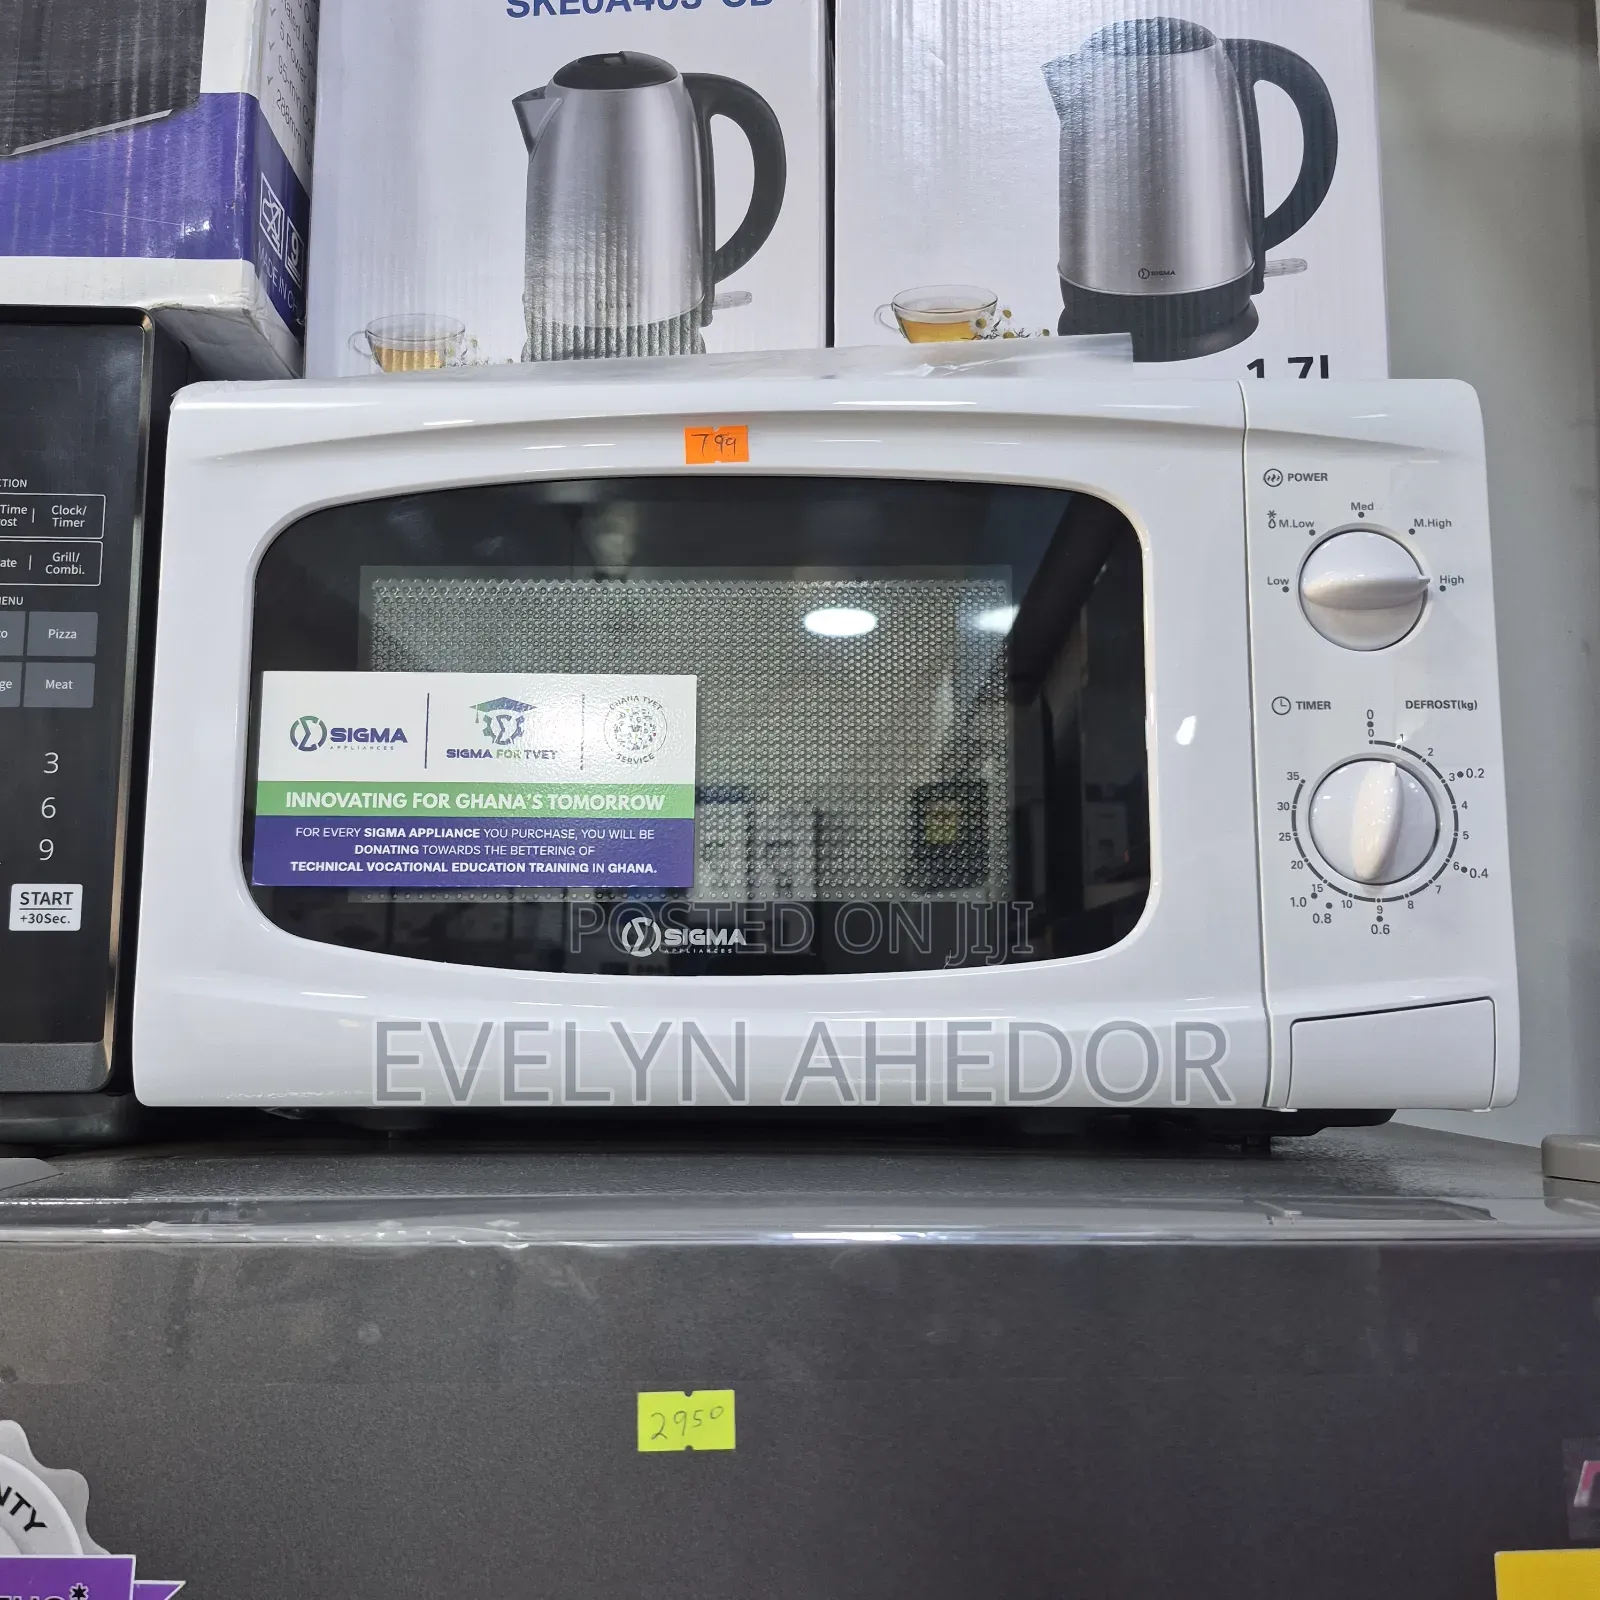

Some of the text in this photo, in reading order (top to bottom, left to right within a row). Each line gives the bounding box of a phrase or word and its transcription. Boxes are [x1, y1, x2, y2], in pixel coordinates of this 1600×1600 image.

[286, 33, 307, 86] Power
[276, 88, 302, 149] 288mm
[278, 275, 288, 301] IN
[691, 433, 737, 457] 799
[1287, 472, 1329, 482] POWER
[51, 504, 88, 516] Clock/
[1350, 502, 1374, 511] Med
[52, 517, 86, 528] Timer
[1279, 519, 1315, 528] M.Low
[1413, 518, 1452, 528] M.High
[52, 552, 81, 563] Grill/
[45, 564, 85, 575] Combi.
[1267, 576, 1289, 586] Low
[1439, 575, 1465, 585] High
[48, 629, 78, 640] Pizza
[45, 679, 73, 690] Meat
[643, 696, 663, 711] TVET
[1296, 700, 1331, 710] TIMER
[1405, 699, 1478, 711] DEFROST(kg)
[1366, 709, 1374, 720] 0
[330, 727, 408, 743] SIGMA
[1367, 728, 1375, 738] 0
[446, 749, 557, 760] SIGMA FOR TVET
[1427, 747, 1434, 757] 2
[43, 751, 60, 774] 3
[1286, 771, 1300, 781] 35
[1448, 772, 1456, 782] 3
[1465, 768, 1485, 779] 0.2
[285, 791, 666, 811] INNOVATING FOR GHANA'S TOMORROW
[1277, 802, 1290, 811] 30
[1461, 801, 1468, 810] 4
[41, 796, 57, 819] 6
[295, 827, 655, 841] FOR EVERY SIGMA APPLIANCE YOU PURCHASE, YOU WILL BE
[1278, 832, 1292, 842] 25
[1462, 831, 1469, 840] 5
[39, 838, 54, 861] 9
[354, 844, 595, 856] DONATING TOWARDS THE BETTERING OF
[290, 861, 657, 874] TECHNICAL VOCATIONAL EDUCATION TRAINING IN GHANA.
[1290, 860, 1304, 870] 20
[1452, 861, 1460, 871] 6
[1469, 868, 1489, 879] 0.4
[1312, 883, 1324, 893] 15
[1434, 885, 1442, 894] 7
[19, 891, 74, 906] START
[1290, 897, 1307, 908] 1.0
[1341, 899, 1353, 909] 10
[1376, 905, 1383, 914] 9
[1407, 900, 1414, 910] 8
[19, 913, 71, 924] +30Sec.
[1312, 913, 1332, 924] 0.8
[1370, 924, 1390, 935] 0.6
[664, 928, 748, 946] SIGMA
[650, 1405, 725, 1441] 2950
